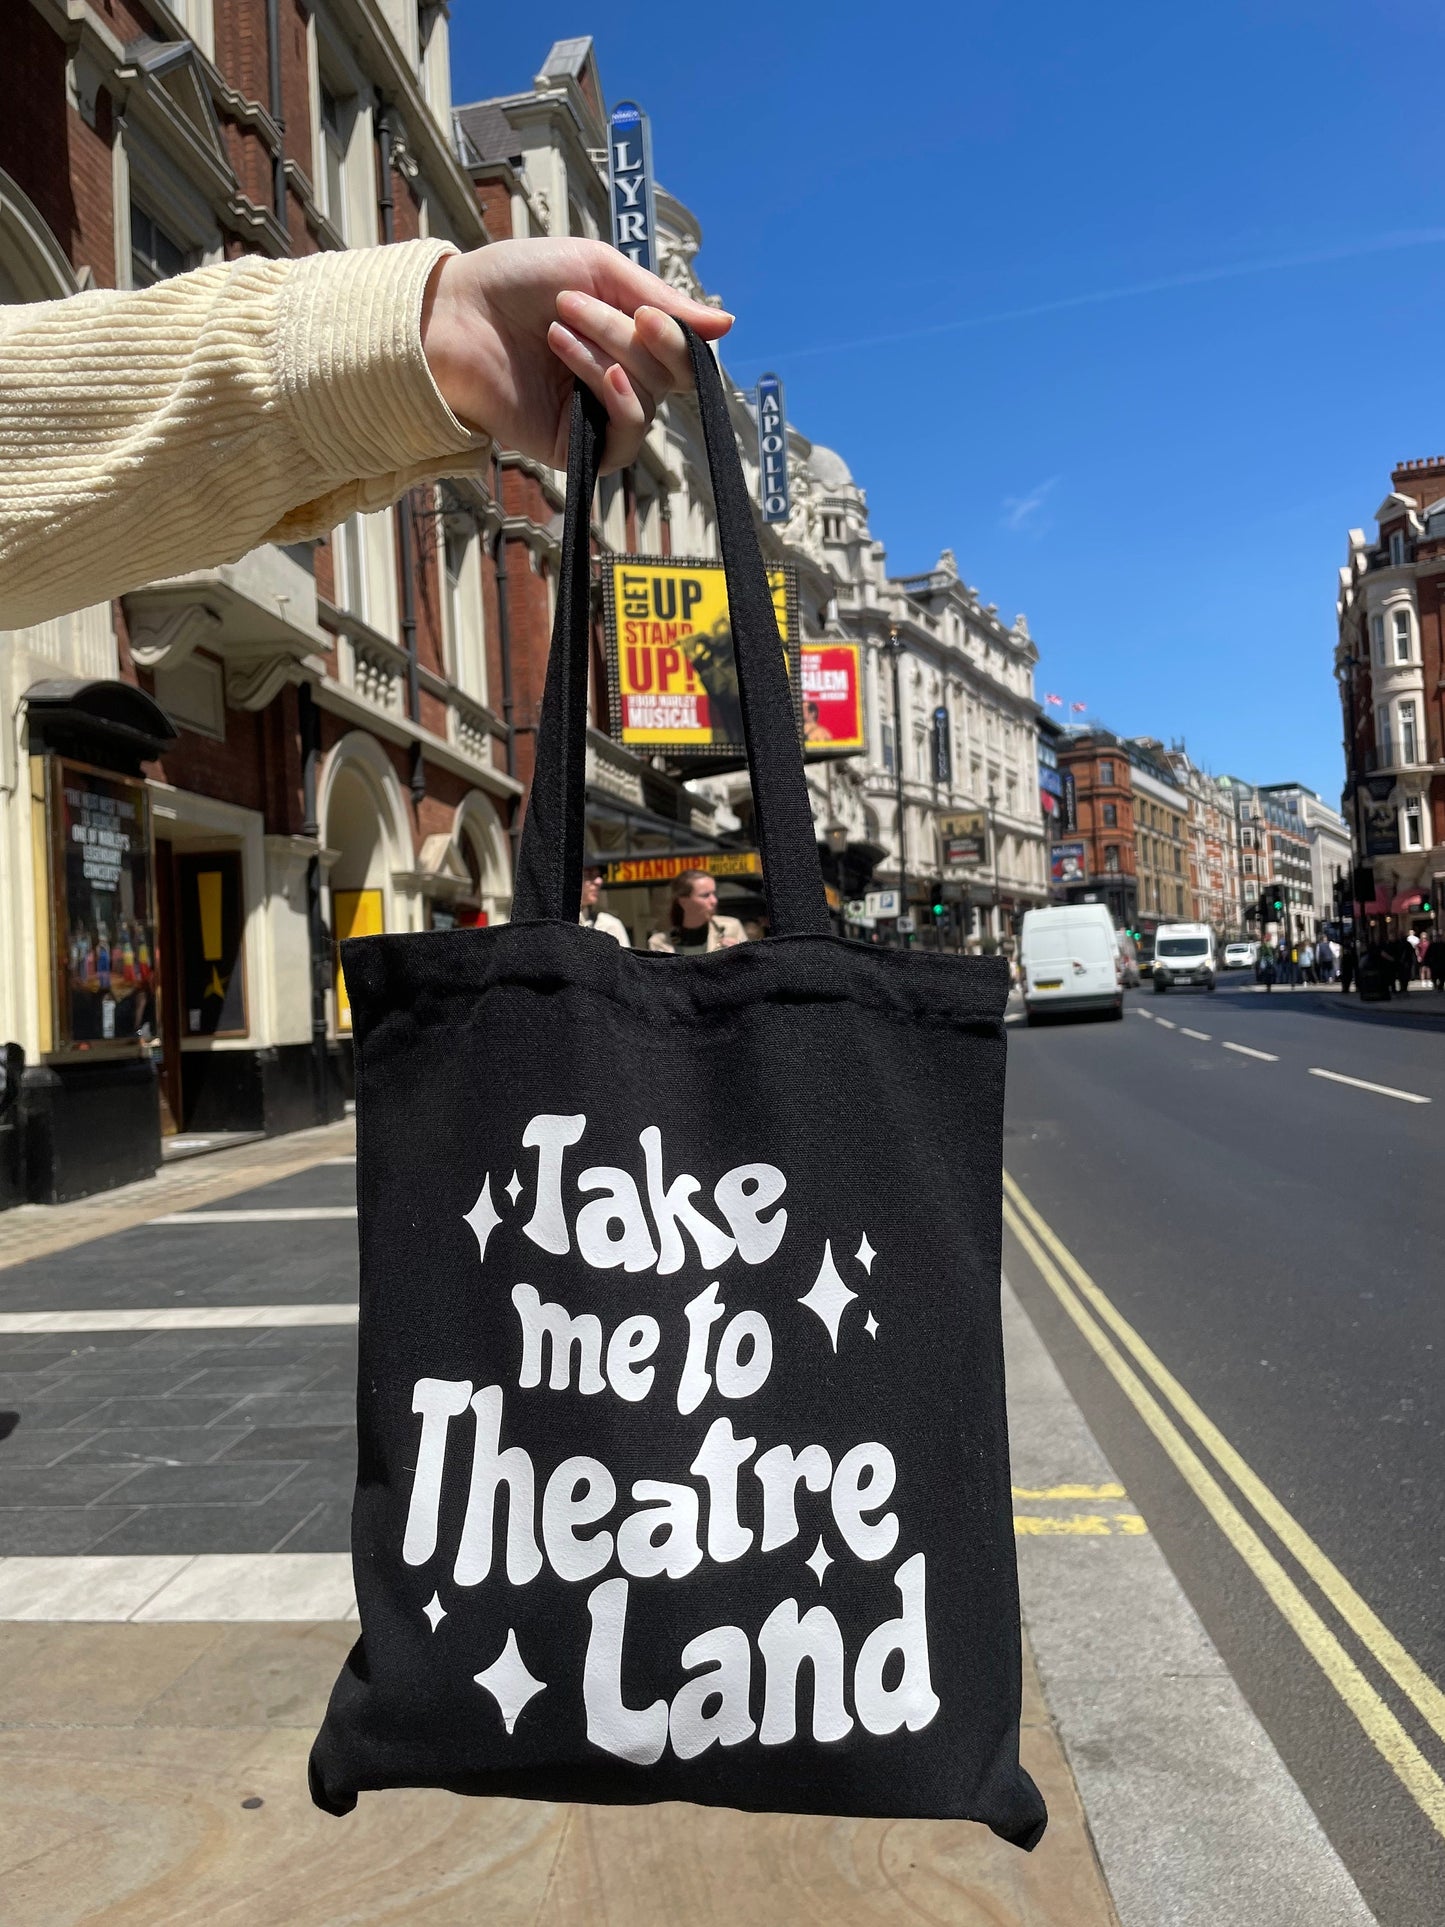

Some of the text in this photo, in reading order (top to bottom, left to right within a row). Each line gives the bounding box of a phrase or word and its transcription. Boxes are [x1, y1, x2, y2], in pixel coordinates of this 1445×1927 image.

[614, 141, 648, 266] LYRI
[762, 394, 786, 514] APOLLO
[623, 572, 702, 620] GET UP
[625, 621, 693, 646] STAND
[626, 646, 697, 693] UP!
[628, 708, 702, 728] MUSICAL
[621, 857, 677, 881] STAND
[522, 1114, 788, 1275] Take
[512, 1281, 773, 1416] me to
[403, 1378, 900, 1586] Theatre
[583, 1553, 940, 1764] Land
